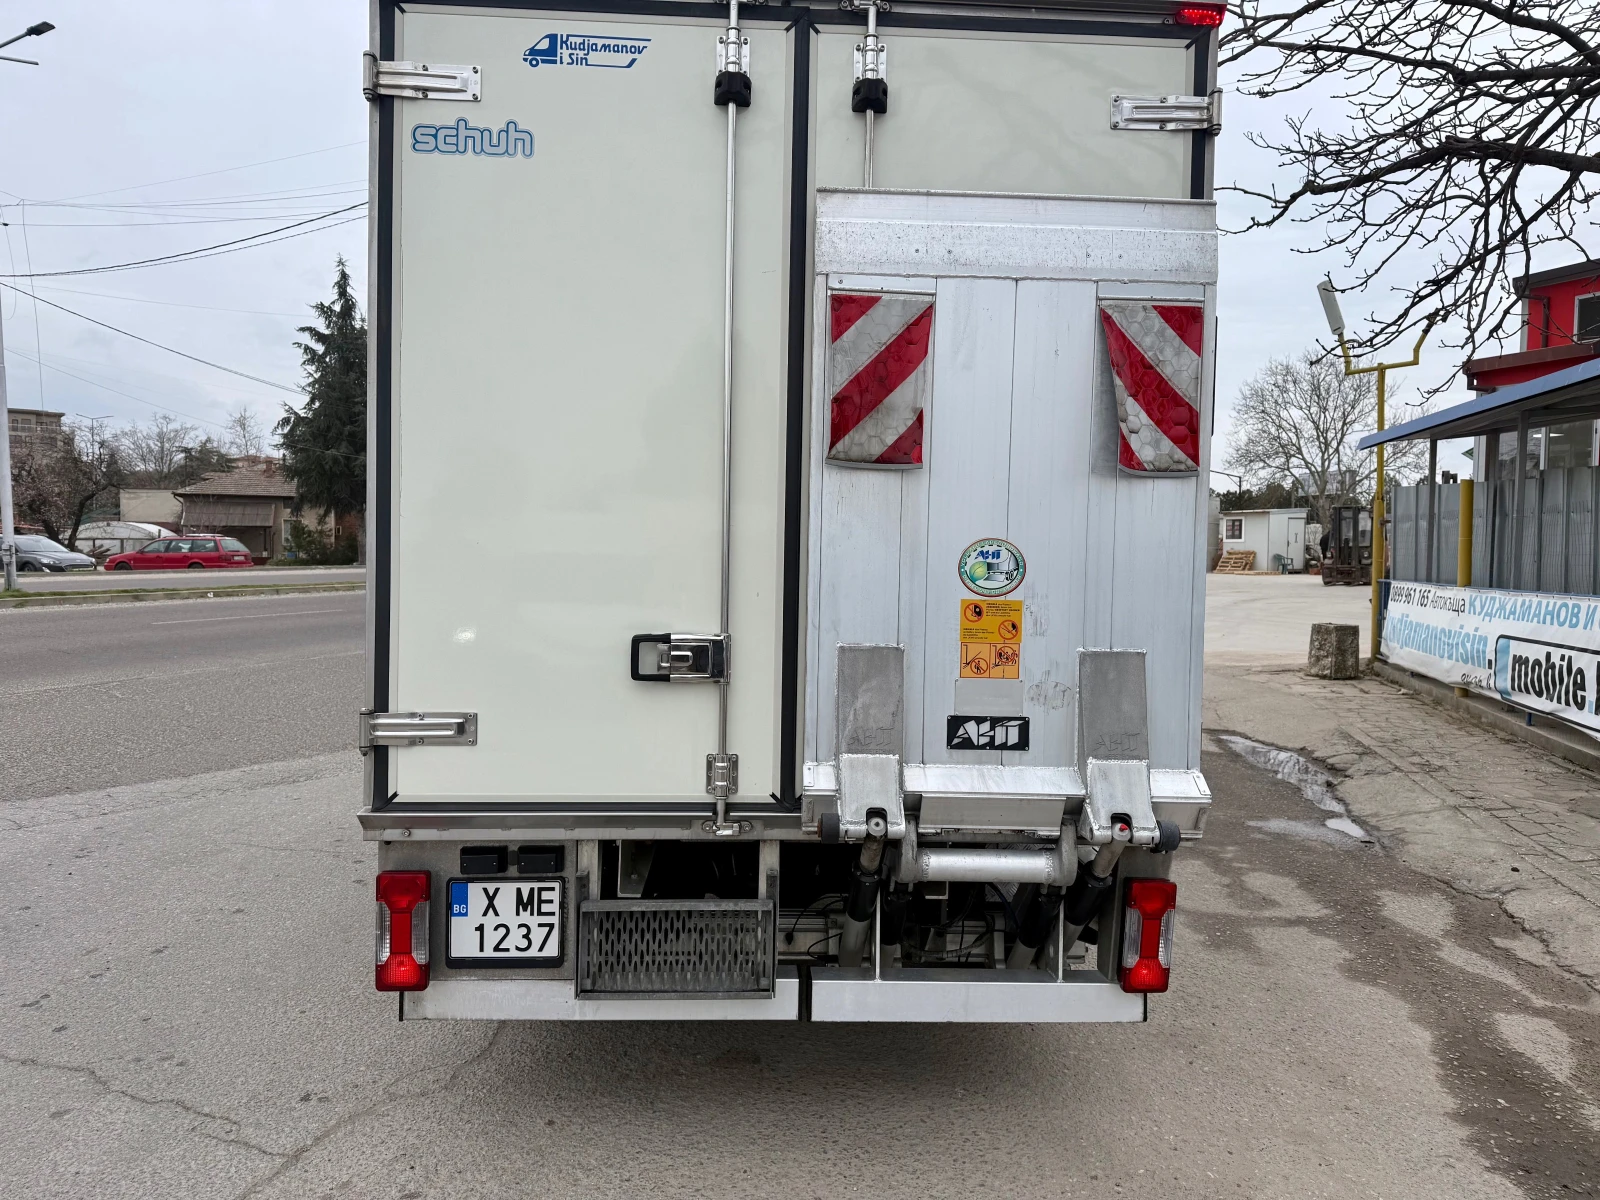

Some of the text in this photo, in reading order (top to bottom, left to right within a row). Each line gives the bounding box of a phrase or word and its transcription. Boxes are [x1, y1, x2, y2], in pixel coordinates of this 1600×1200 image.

[559, 34, 648, 56] Kudjamanov
[559, 52, 589, 67] i Sin
[411, 117, 535, 159] schuh
[1390, 585, 1405, 603] 0899
[1403, 587, 1416, 606] 961
[1416, 589, 1431, 608] 165
[1429, 590, 1466, 617] Автокъща
[1468, 594, 1582, 629] КУДЖАМАНОВ
[1582, 603, 1598, 631] И
[1510, 651, 1600, 716] mobile.
[453, 904, 467, 914] BG
[481, 887, 556, 917] X ME
[474, 923, 555, 953] 1237
